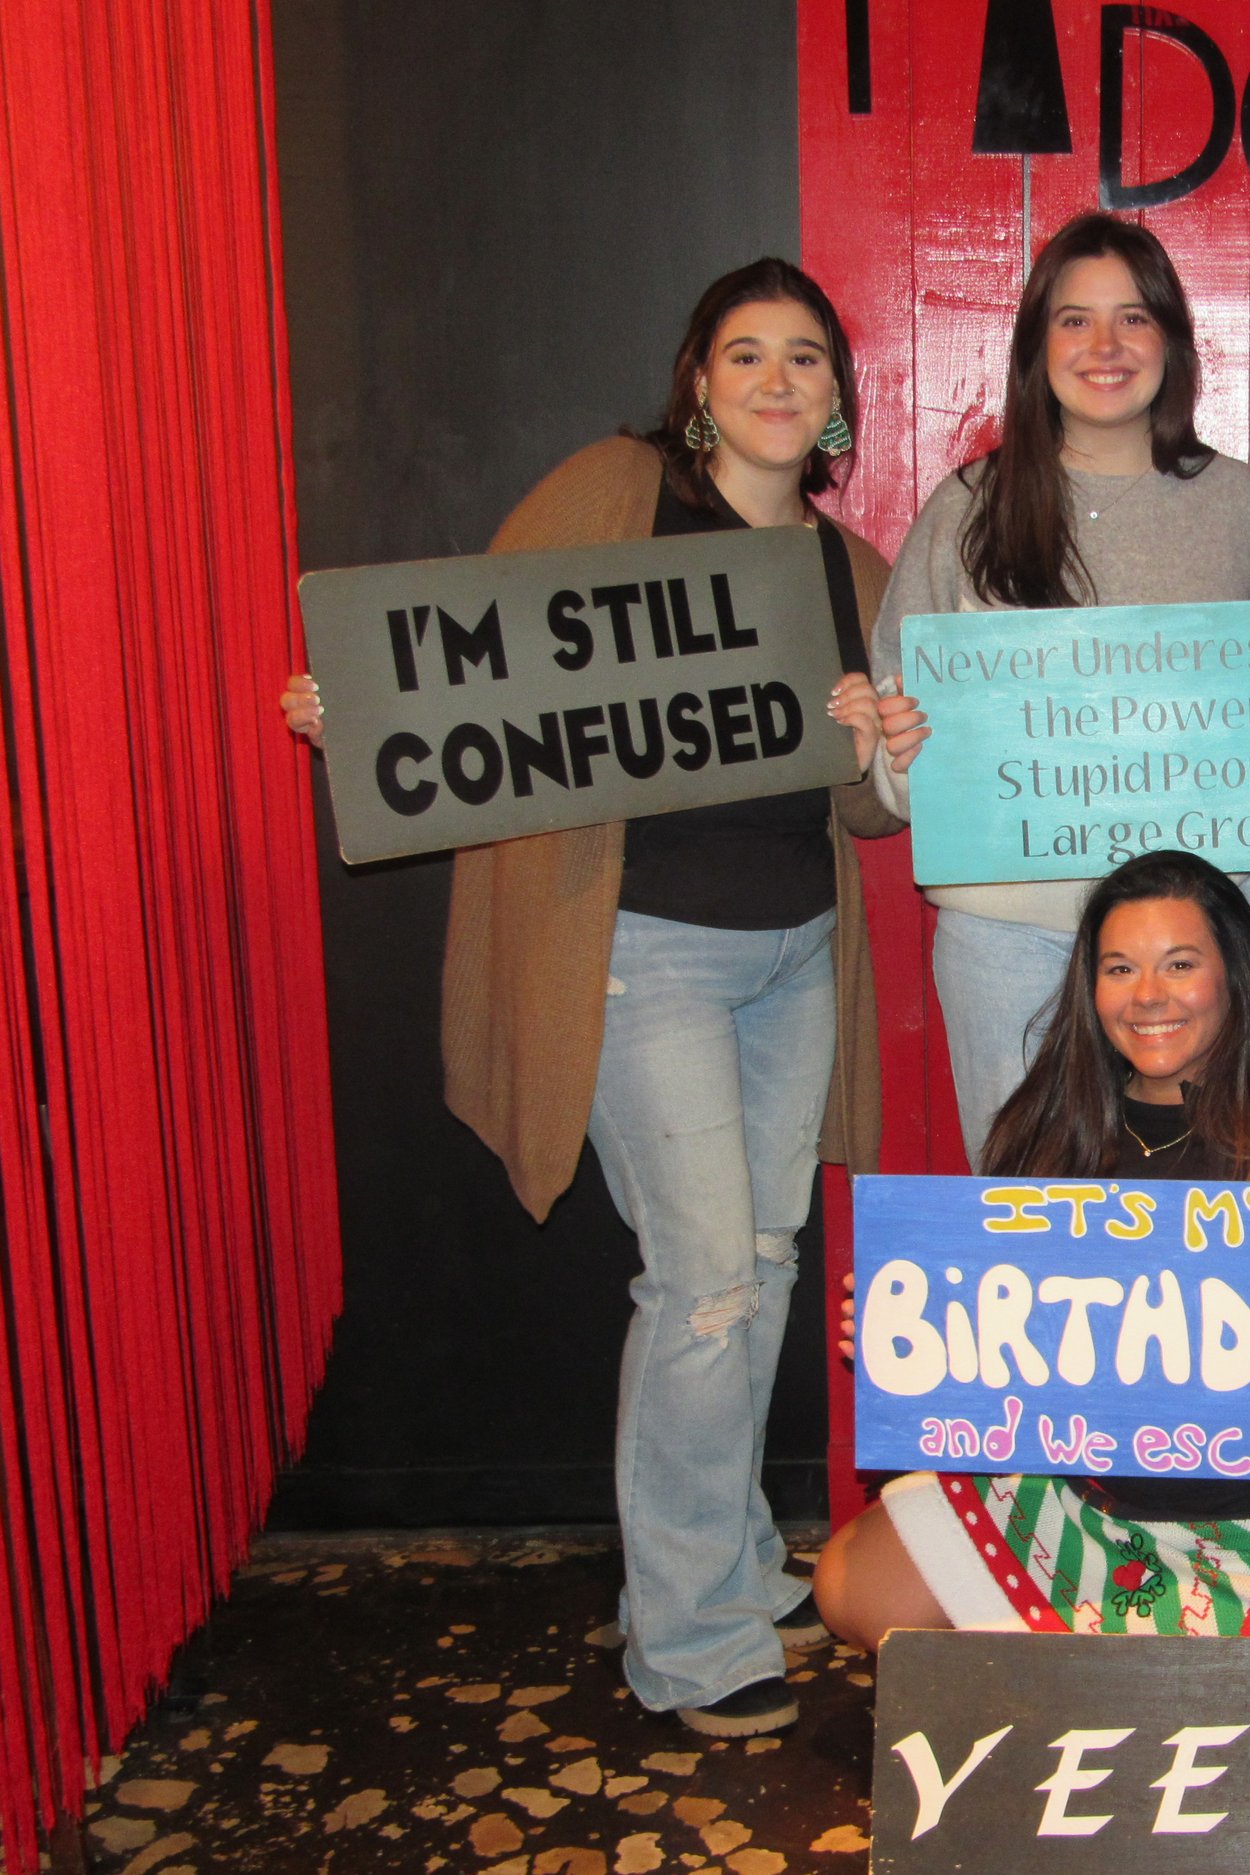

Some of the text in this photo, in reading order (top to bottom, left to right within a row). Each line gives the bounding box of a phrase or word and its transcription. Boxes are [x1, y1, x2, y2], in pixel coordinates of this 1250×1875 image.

[387, 573, 758, 692] I'M STILL
[915, 644, 1058, 684] Never
[1020, 698, 1099, 739] the
[376, 681, 803, 817] CONFUSED
[997, 752, 1151, 807] Stupid
[1022, 819, 1162, 865] Large
[981, 1183, 1156, 1240] IT'S
[920, 1396, 1022, 1461] and
